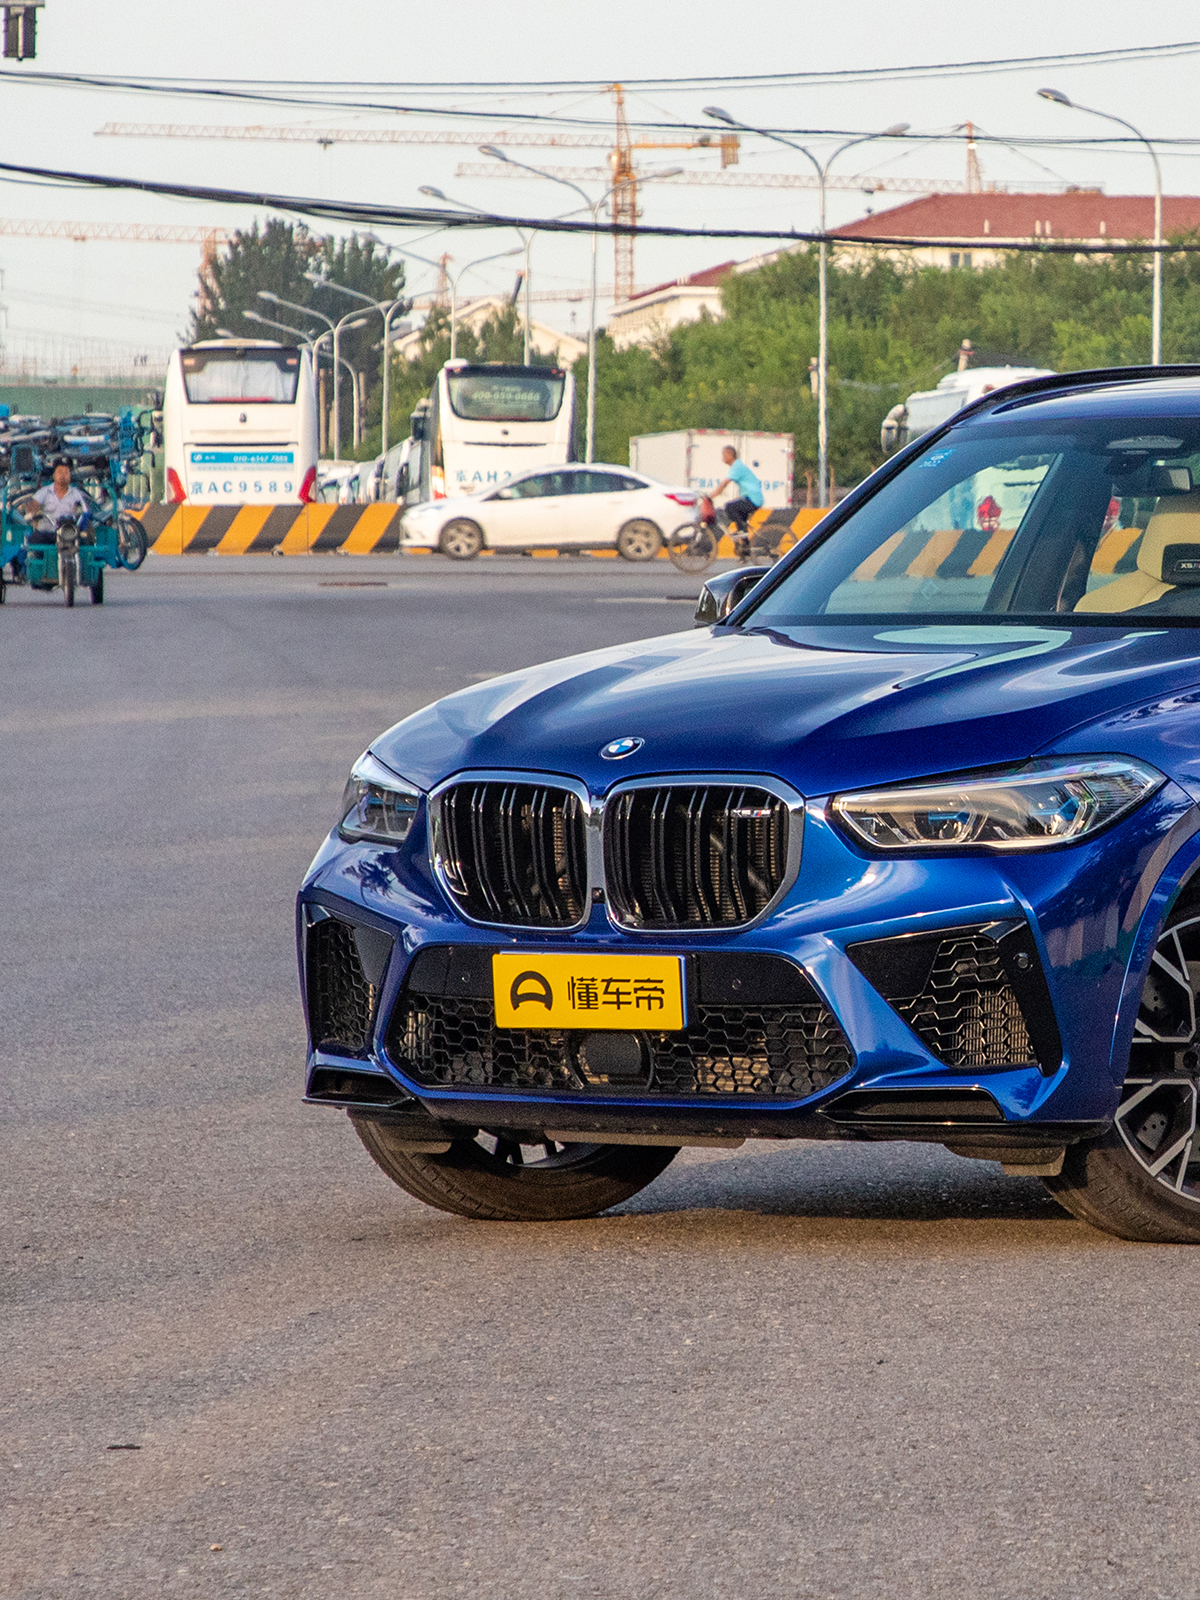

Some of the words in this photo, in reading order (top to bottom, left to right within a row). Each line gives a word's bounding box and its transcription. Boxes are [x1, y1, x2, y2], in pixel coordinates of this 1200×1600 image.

[190, 480, 293, 495] 京AC9589
[567, 976, 666, 1011] 懂车帝
